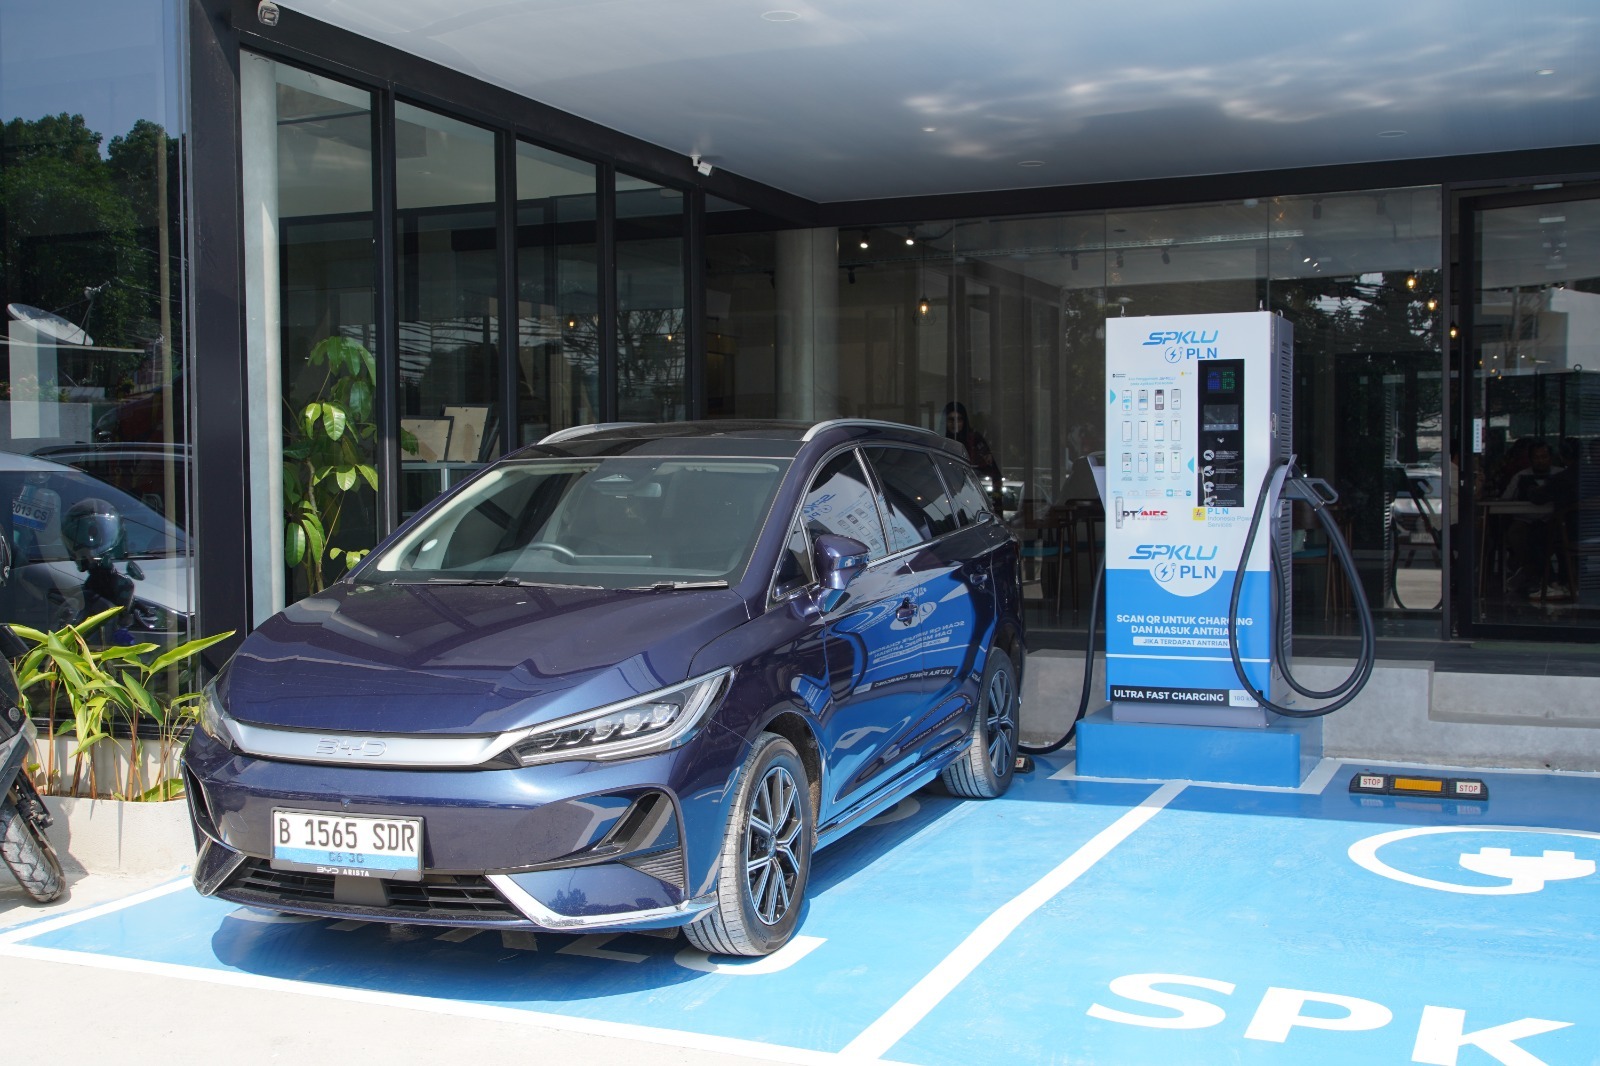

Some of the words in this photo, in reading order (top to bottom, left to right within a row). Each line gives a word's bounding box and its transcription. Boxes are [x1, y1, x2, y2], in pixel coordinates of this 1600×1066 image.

[1142, 329, 1219, 345] SPKLU
[1186, 347, 1217, 359] PLN
[1207, 507, 1229, 515] PLN
[1128, 544, 1218, 560] SPKLU
[1180, 565, 1217, 579] PLN
[1116, 614, 1145, 623] SCAN
[1146, 615, 1160, 624] QR
[1162, 615, 1196, 625] UNTUK
[1198, 616, 1253, 626] CHARING
[1131, 625, 1153, 634] DAN
[1154, 626, 1190, 635] MASUK
[1113, 689, 1144, 699] ULTRA
[1146, 690, 1170, 700] FAST
[1171, 691, 1224, 702] CHARGING
[316, 737, 388, 757] BYD
[1459, 784, 1478, 792] STOP
[279, 817, 291, 844] B
[304, 818, 358, 849] 1565
[372, 823, 415, 852] SDR
[316, 866, 339, 875] BYD
[342, 868, 370, 877] ARISTA
